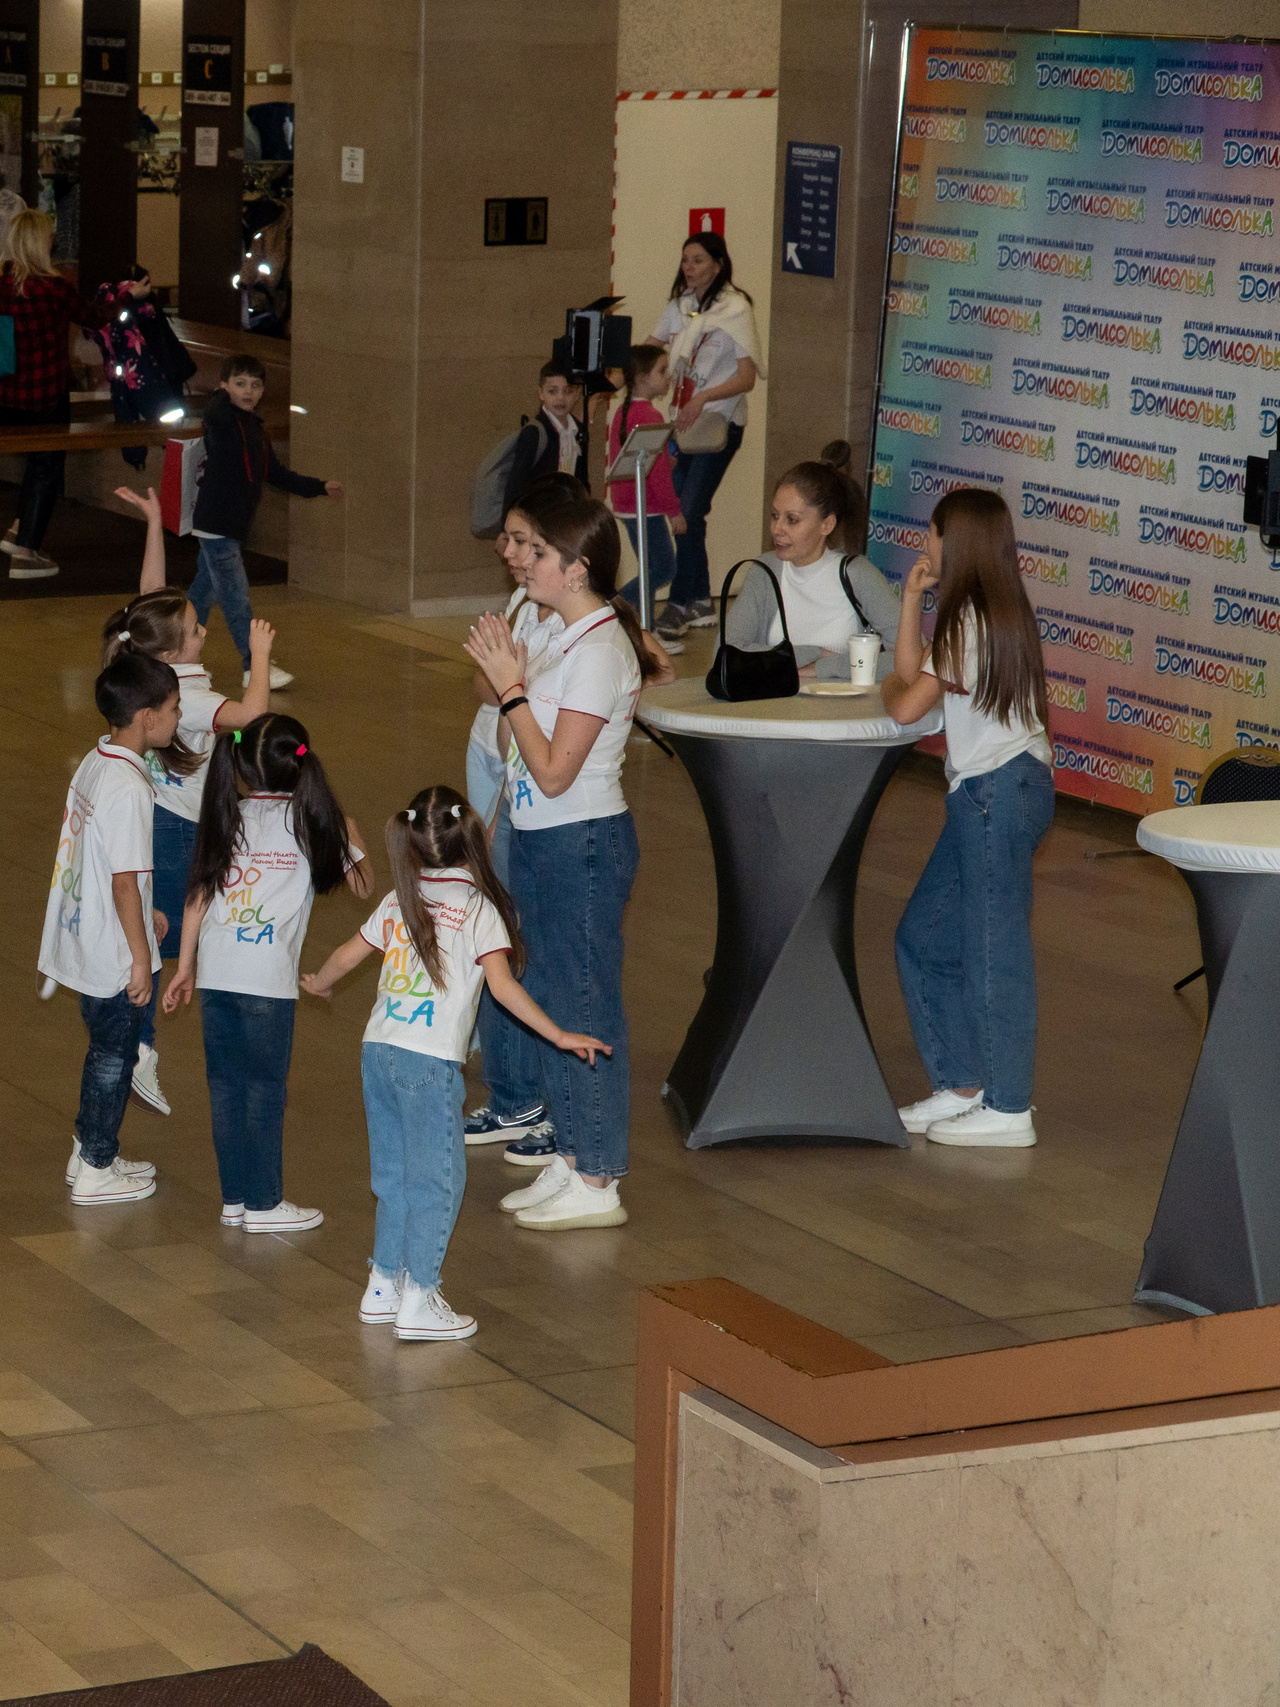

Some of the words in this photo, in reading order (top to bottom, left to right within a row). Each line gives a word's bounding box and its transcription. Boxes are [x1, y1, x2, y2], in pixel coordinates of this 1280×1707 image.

[204, 60, 213, 79] C
[998, 233, 1024, 244] ДЕТСКИЙ
[1025, 236, 1074, 249] МУЗЫКАЛЬНЫЙ
[1075, 241, 1094, 252] ТЕАТР
[1114, 247, 1142, 259] ДЕТСКИЙ
[1143, 250, 1194, 264] МУЗЫКАЛЬНЫЙ
[1196, 255, 1216, 266] ТЕАТР
[948, 287, 974, 299] ДЕТСКИЙ
[976, 290, 1023, 305] МУЗЫКАЛЬНЫЙ
[1024, 297, 1042, 308] ТЕАТР
[1062, 303, 1089, 315] ДЕТСКИЙ
[1091, 306, 1141, 321] МУЗЫКАЛЬНЫЙ
[1143, 312, 1162, 324] ТЕАТР
[1184, 320, 1213, 333] ДЕТСКИЙ
[1215, 324, 1270, 339] МУЗЫКАЛЬНЫЙ
[902, 340, 927, 352] ДЕТСКИЙ
[928, 343, 974, 358] МУЗЫКАЛЬНЫЙ
[975, 350, 993, 361] ТЕАТР
[1012, 357, 1039, 370] ДЕТСКИЙ
[1041, 361, 1089, 377] МУЗЫКАЛЬНЫЙ
[1091, 368, 1110, 380] ТЕАТР
[1131, 376, 1160, 389] ДЕТСКИЙ
[1161, 380, 1214, 397] МУЗЫКАЛЬНЫЙ
[1216, 388, 1236, 400] ТЕАТР
[961, 409, 987, 422] ДЕТСКИЙ
[989, 413, 1036, 429] МУЗЫКАЛЬНЫЙ
[1038, 421, 1056, 432] ТЕАТР
[1076, 430, 1103, 444] ДЕТСКИЙ
[1105, 435, 1156, 453] МУЗЫКАЛЬНЫЙ
[1157, 444, 1177, 456] ТЕАТР
[911, 458, 936, 471] ДЕТСКИЙ
[938, 463, 984, 480] МУЗЫКАЛЬНЫЙ
[986, 471, 1004, 483] ТЕАТР
[1022, 481, 1049, 494] ДЕТСКИЙ
[1051, 486, 1100, 503] МУЗЫКАЛЬНЫЙ
[1101, 495, 1120, 507] ТЕАТР
[1139, 504, 1169, 519] ДЕТСКИЙ
[1171, 510, 1225, 529] МУЗЫКАЛЬНЫЙ
[1226, 521, 1247, 534] ТЕАТР
[1050, 546, 1069, 558] ТЕАТР
[1089, 556, 1117, 571] ДЕТСКИЙ
[1118, 562, 1169, 582] МУЗЫКАЛЬНЫЙ
[1171, 573, 1191, 586] ТЕАТР
[1064, 612, 1114, 632] МУЗЫКАЛЬНЫЙ
[1115, 624, 1134, 637] ТЕАТР
[1156, 635, 1186, 650] ДЕТСКИЙ
[1188, 642, 1243, 663] МУЗЫКАЛЬНЫЙ
[1245, 654, 1267, 668] ТЕАТР
[1107, 685, 1136, 701] ДЕТСКИЙ
[1137, 693, 1190, 714] МУЗЫКАЛЬНЫЙ
[1192, 706, 1212, 720] ТЕАТР
[1054, 731, 1082, 748] ДЕТСКИЙ
[1083, 739, 1133, 762] МУЗЫКАЛЬНЫЙ
[1135, 754, 1154, 768] ТЕАТР
[223, 865, 262, 888] DO
[226, 887, 252, 906] MI
[237, 924, 274, 944] KA
[385, 996, 435, 1027] KA
